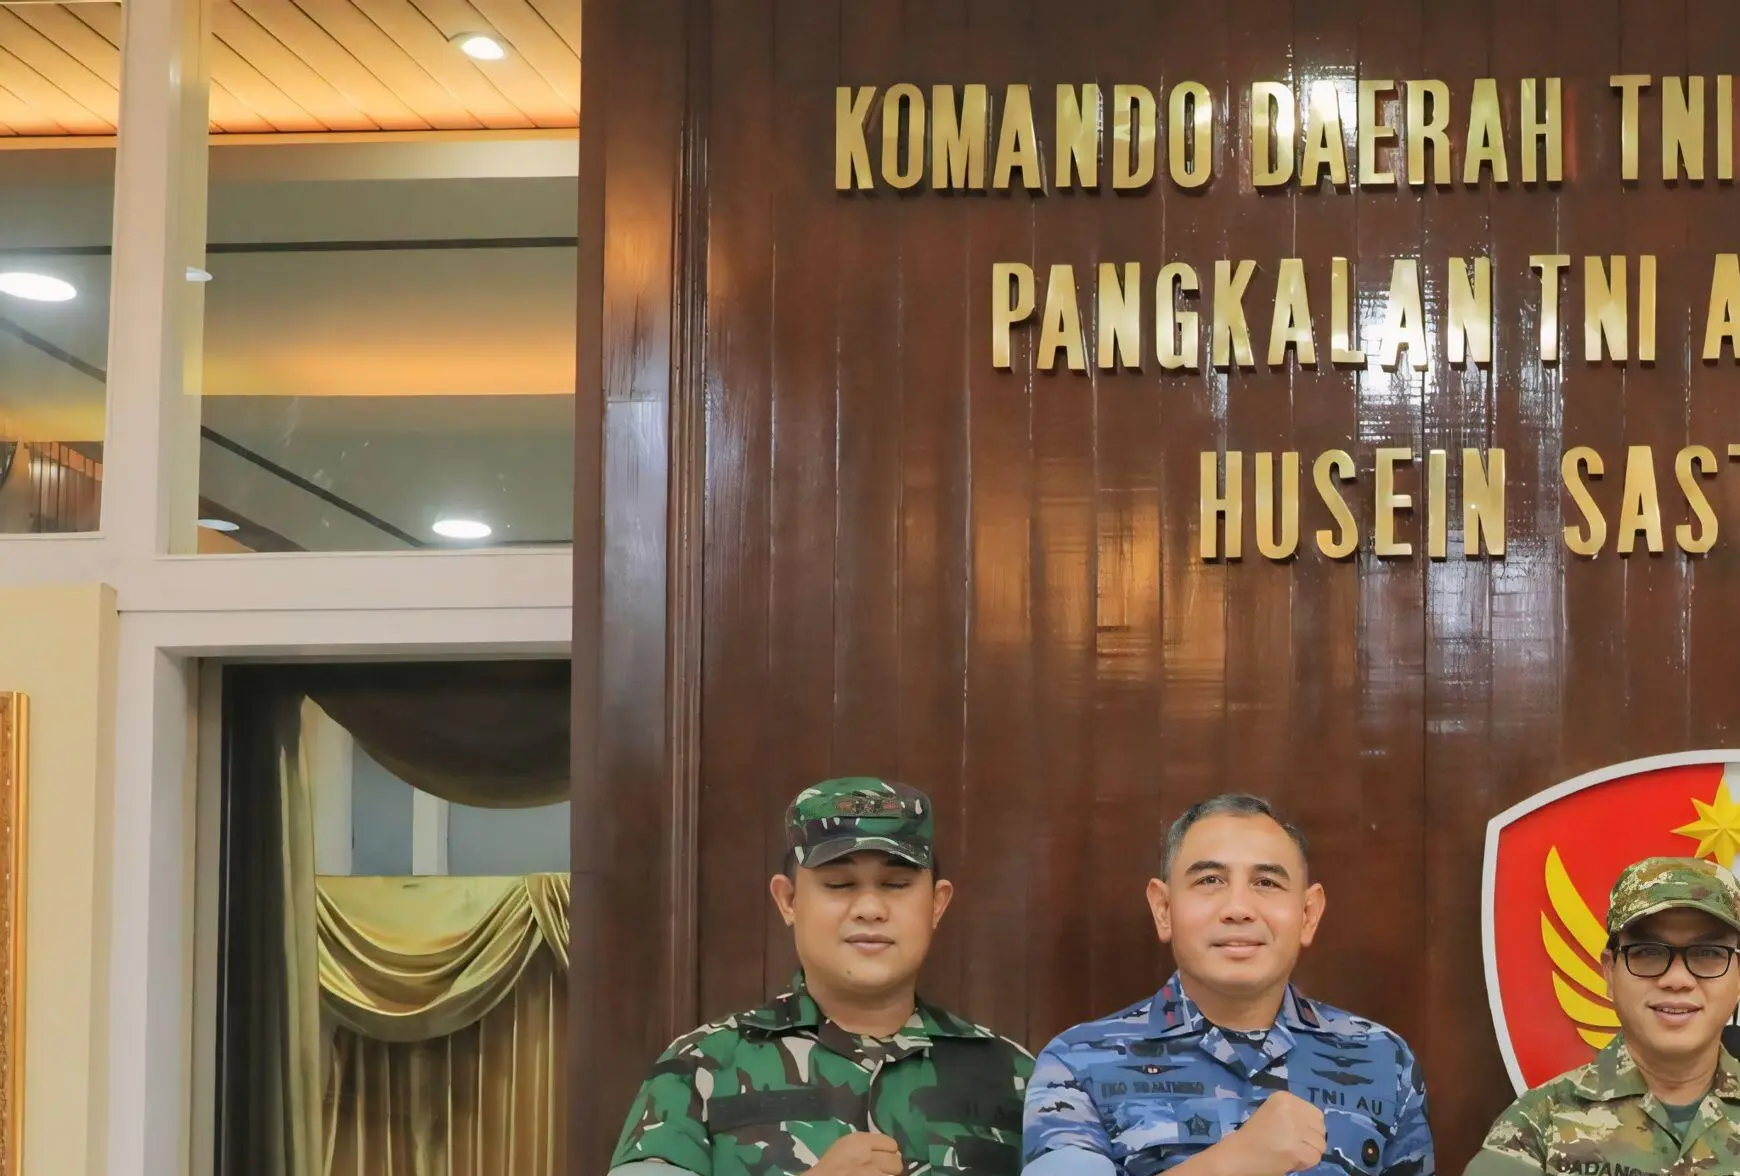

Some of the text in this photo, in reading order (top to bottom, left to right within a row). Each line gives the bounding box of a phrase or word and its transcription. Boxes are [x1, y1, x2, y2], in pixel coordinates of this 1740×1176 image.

[835, 80, 1212, 190] KOMANDO
[1251, 77, 1563, 188] DAERAH
[1610, 74, 1733, 182] TNI
[992, 256, 1492, 370] PANGKALAN
[1529, 254, 1656, 363] TNI
[1199, 446, 1506, 560] HUSEIN
[1307, 1087, 1382, 1115] TNI AU
